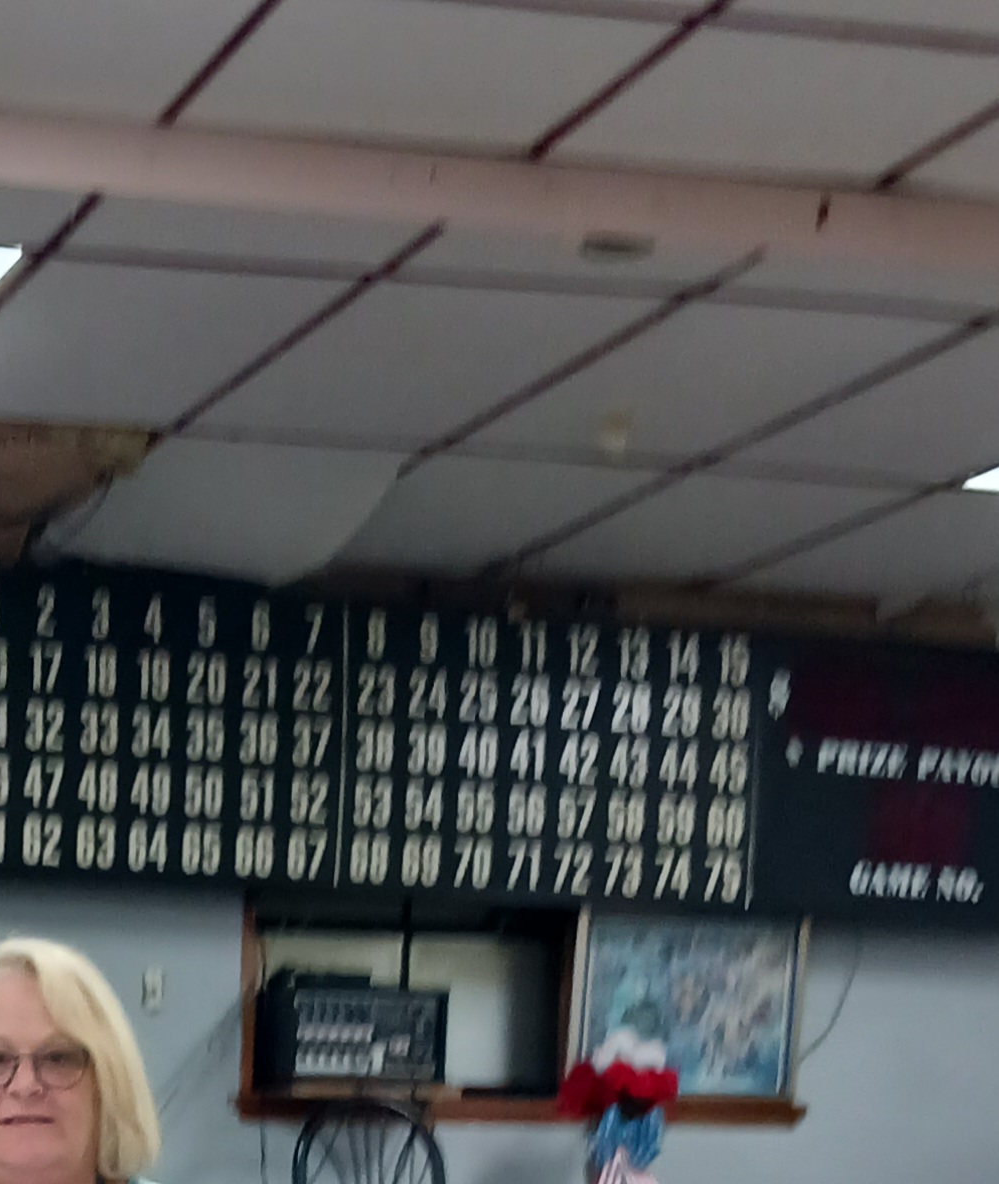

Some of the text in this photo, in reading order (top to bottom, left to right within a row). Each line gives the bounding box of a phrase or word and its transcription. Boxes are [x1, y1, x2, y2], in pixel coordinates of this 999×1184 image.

[35, 584, 56, 638] 2
[142, 596, 162, 644] 4
[305, 605, 324, 655] 7
[467, 618, 498, 669] 10
[520, 622, 547, 673] 11
[568, 627, 598, 678] 12
[668, 633, 700, 684] 14
[30, 643, 63, 693] 17
[185, 653, 226, 705] 20
[241, 657, 277, 708] 21
[291, 660, 332, 712] 22
[356, 666, 396, 716] 23
[407, 667, 447, 720] 24
[559, 678, 601, 731] 27
[22, 756, 64, 809] 47
[23, 698, 65, 752] 32
[130, 706, 171, 759] 34
[291, 716, 332, 768] 37
[509, 727, 546, 781] 41
[558, 731, 600, 786] 42
[658, 739, 699, 791] 44
[21, 813, 62, 867] 62
[127, 819, 168, 873] 64
[452, 836, 492, 889] 70
[506, 839, 542, 892] 71
[552, 843, 593, 895] 72
[653, 847, 691, 900] 74
